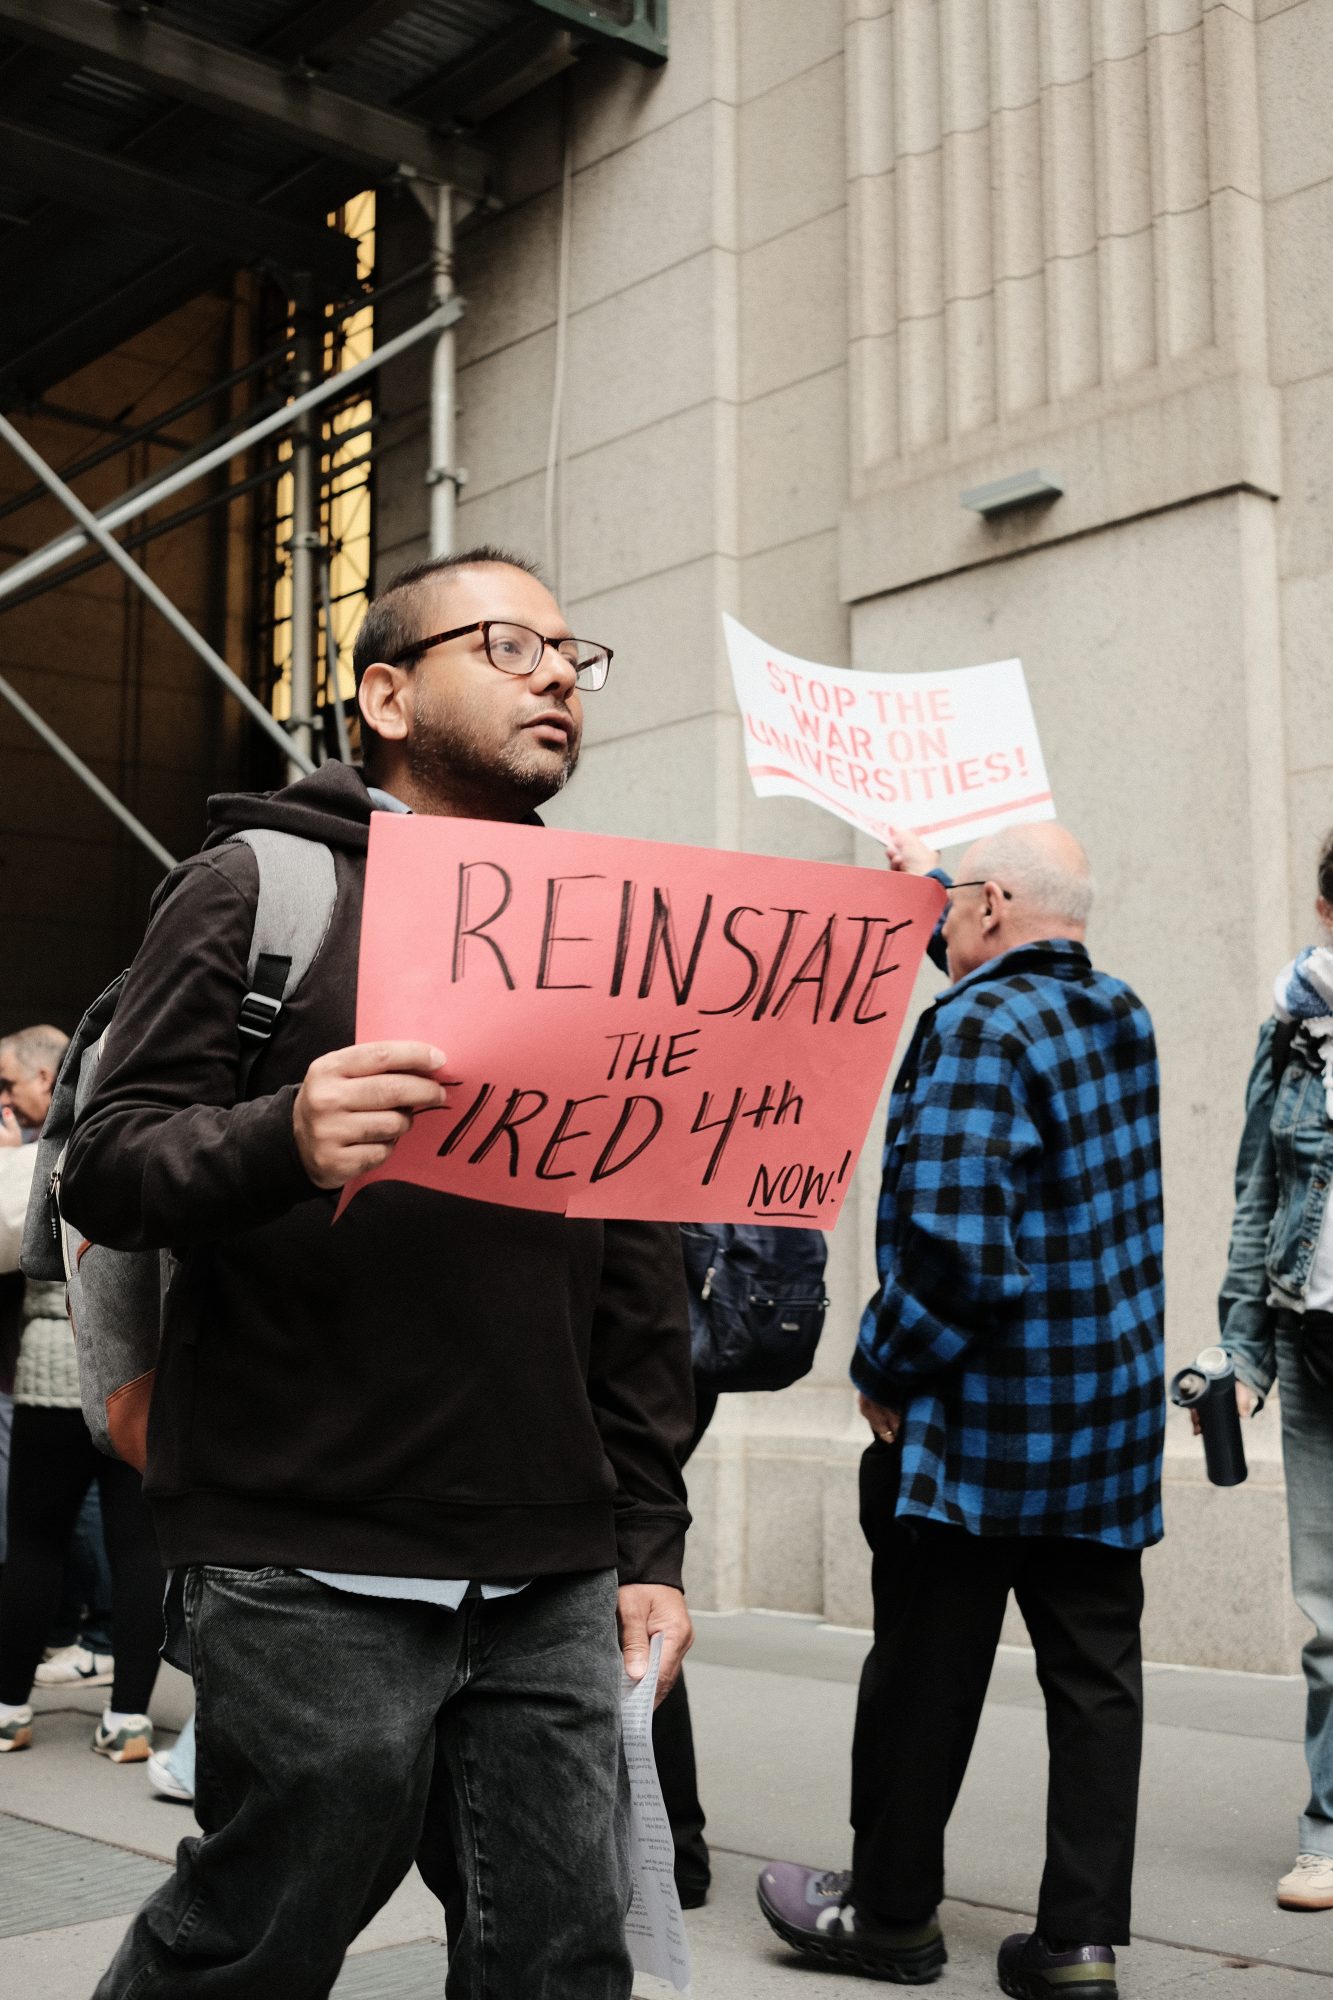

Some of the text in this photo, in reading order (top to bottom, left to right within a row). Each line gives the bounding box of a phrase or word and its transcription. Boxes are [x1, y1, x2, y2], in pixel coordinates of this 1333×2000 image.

[766, 659, 956, 725] STOP THE
[746, 712, 1031, 804] UNIVERSITIES!
[789, 702, 950, 764] WAR ON
[451, 860, 913, 1025] REINSTATE
[605, 1029, 701, 1080] THE
[690, 1080, 803, 1185] 4th
[747, 1150, 852, 1207] NOW!
